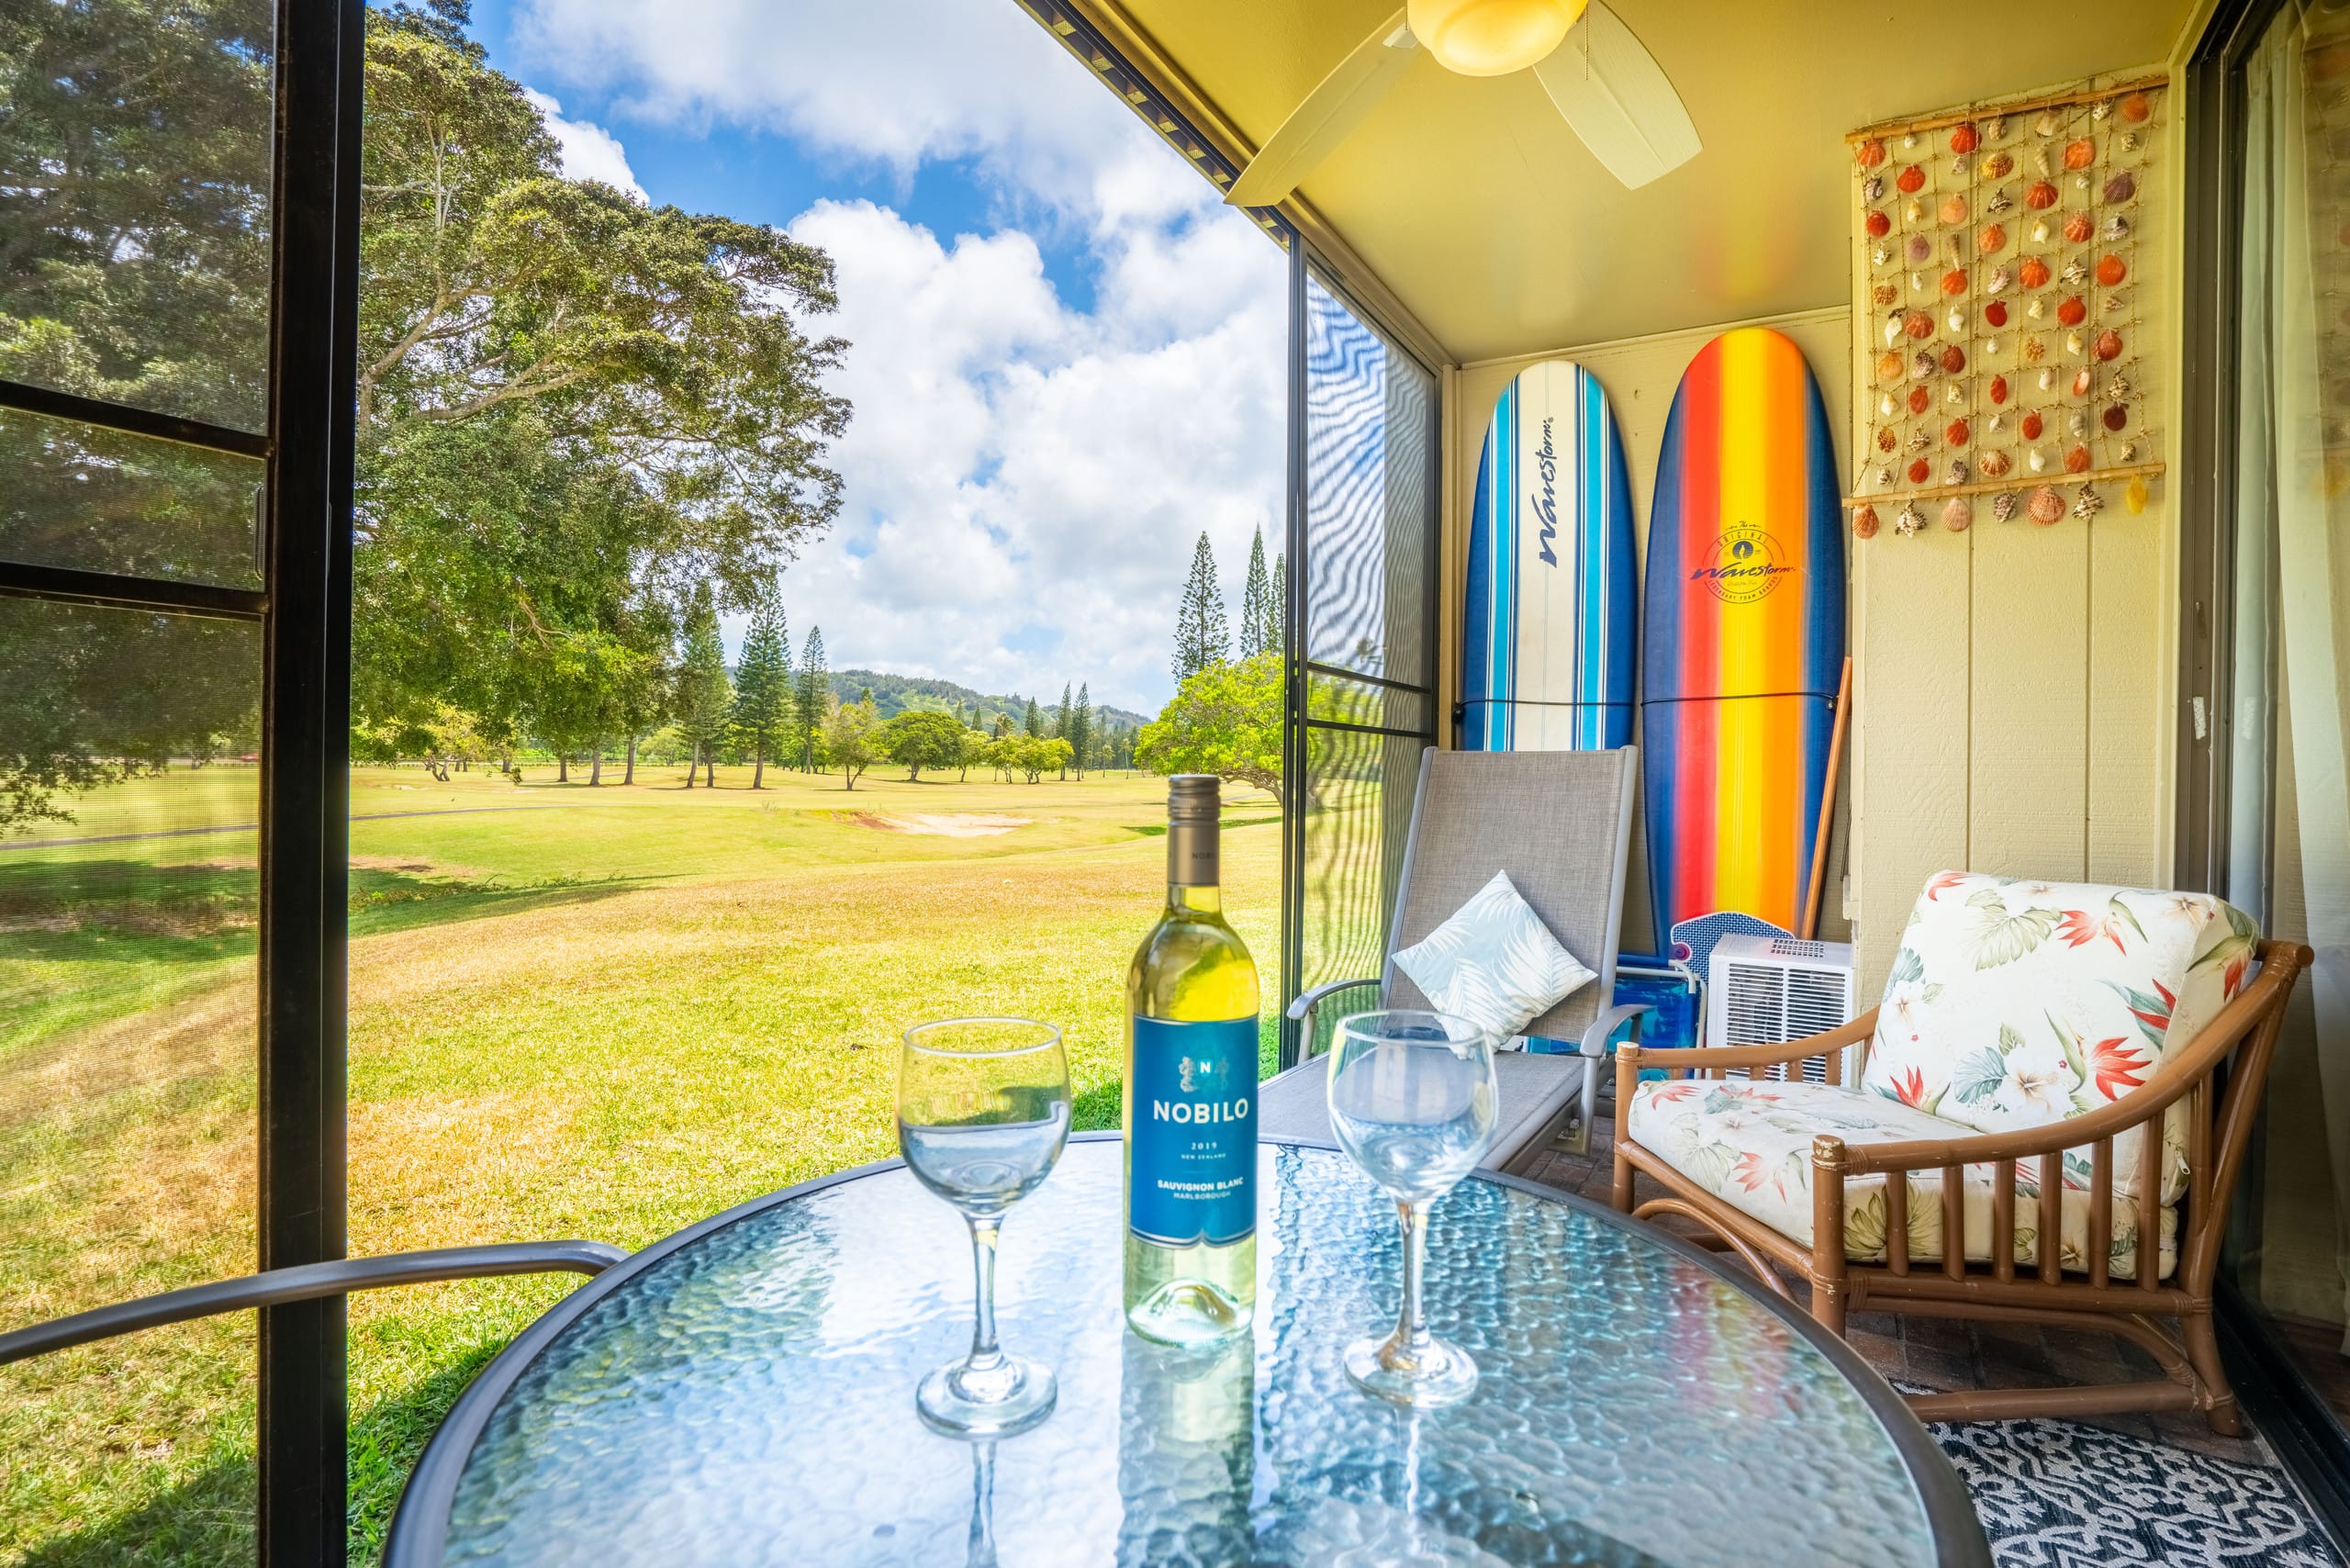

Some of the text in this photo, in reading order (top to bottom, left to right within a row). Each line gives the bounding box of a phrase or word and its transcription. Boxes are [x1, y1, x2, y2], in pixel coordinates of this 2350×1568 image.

[1200, 1061, 1211, 1073] N
[1153, 1098, 1249, 1125] NOBILO
[1191, 1142, 1218, 1150] 2019
[1157, 1176, 1244, 1192] SAUVIGNON BLANC
[1173, 1191, 1232, 1200] MARLBOROUGH
